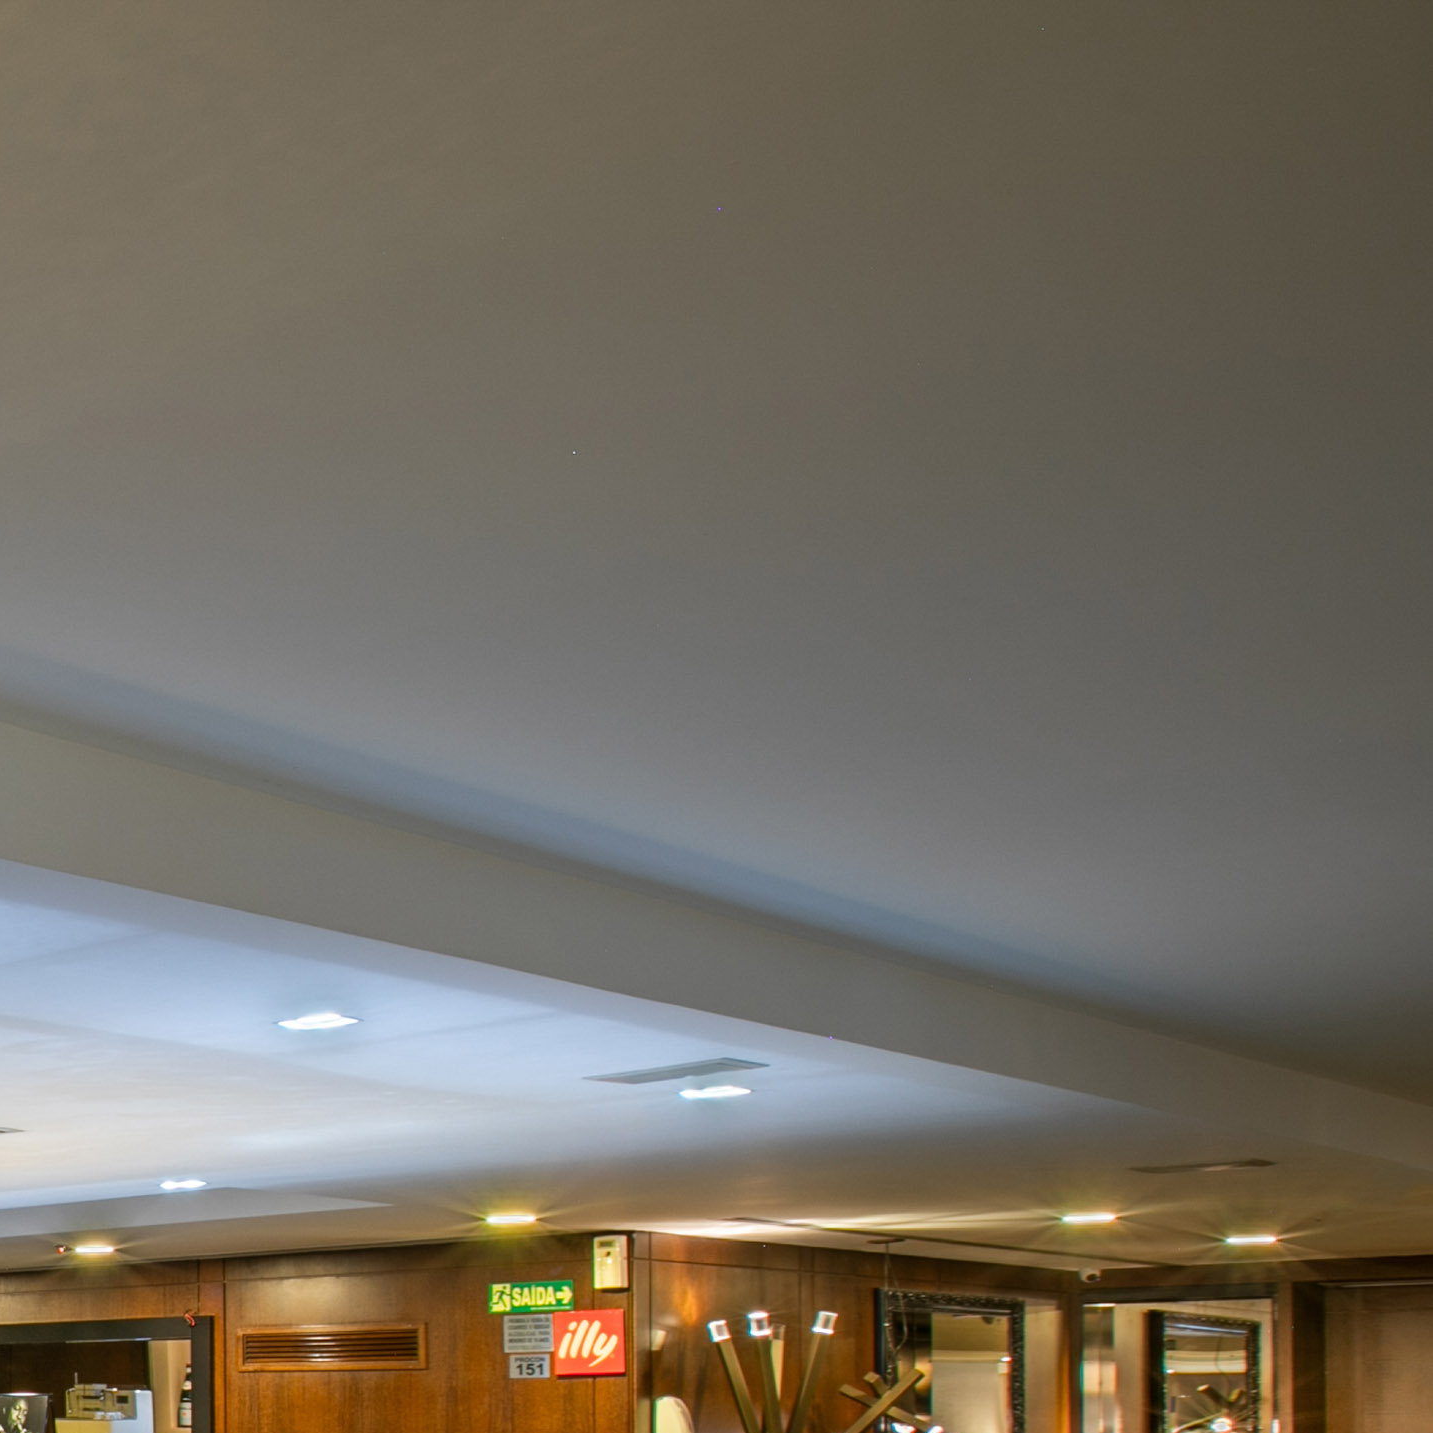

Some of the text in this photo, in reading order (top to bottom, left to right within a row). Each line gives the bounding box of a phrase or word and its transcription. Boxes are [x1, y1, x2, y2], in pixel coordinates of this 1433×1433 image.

[512, 1285, 556, 1306] SAÍDA
[558, 1320, 618, 1367] illy
[516, 1363, 545, 1377] 151
